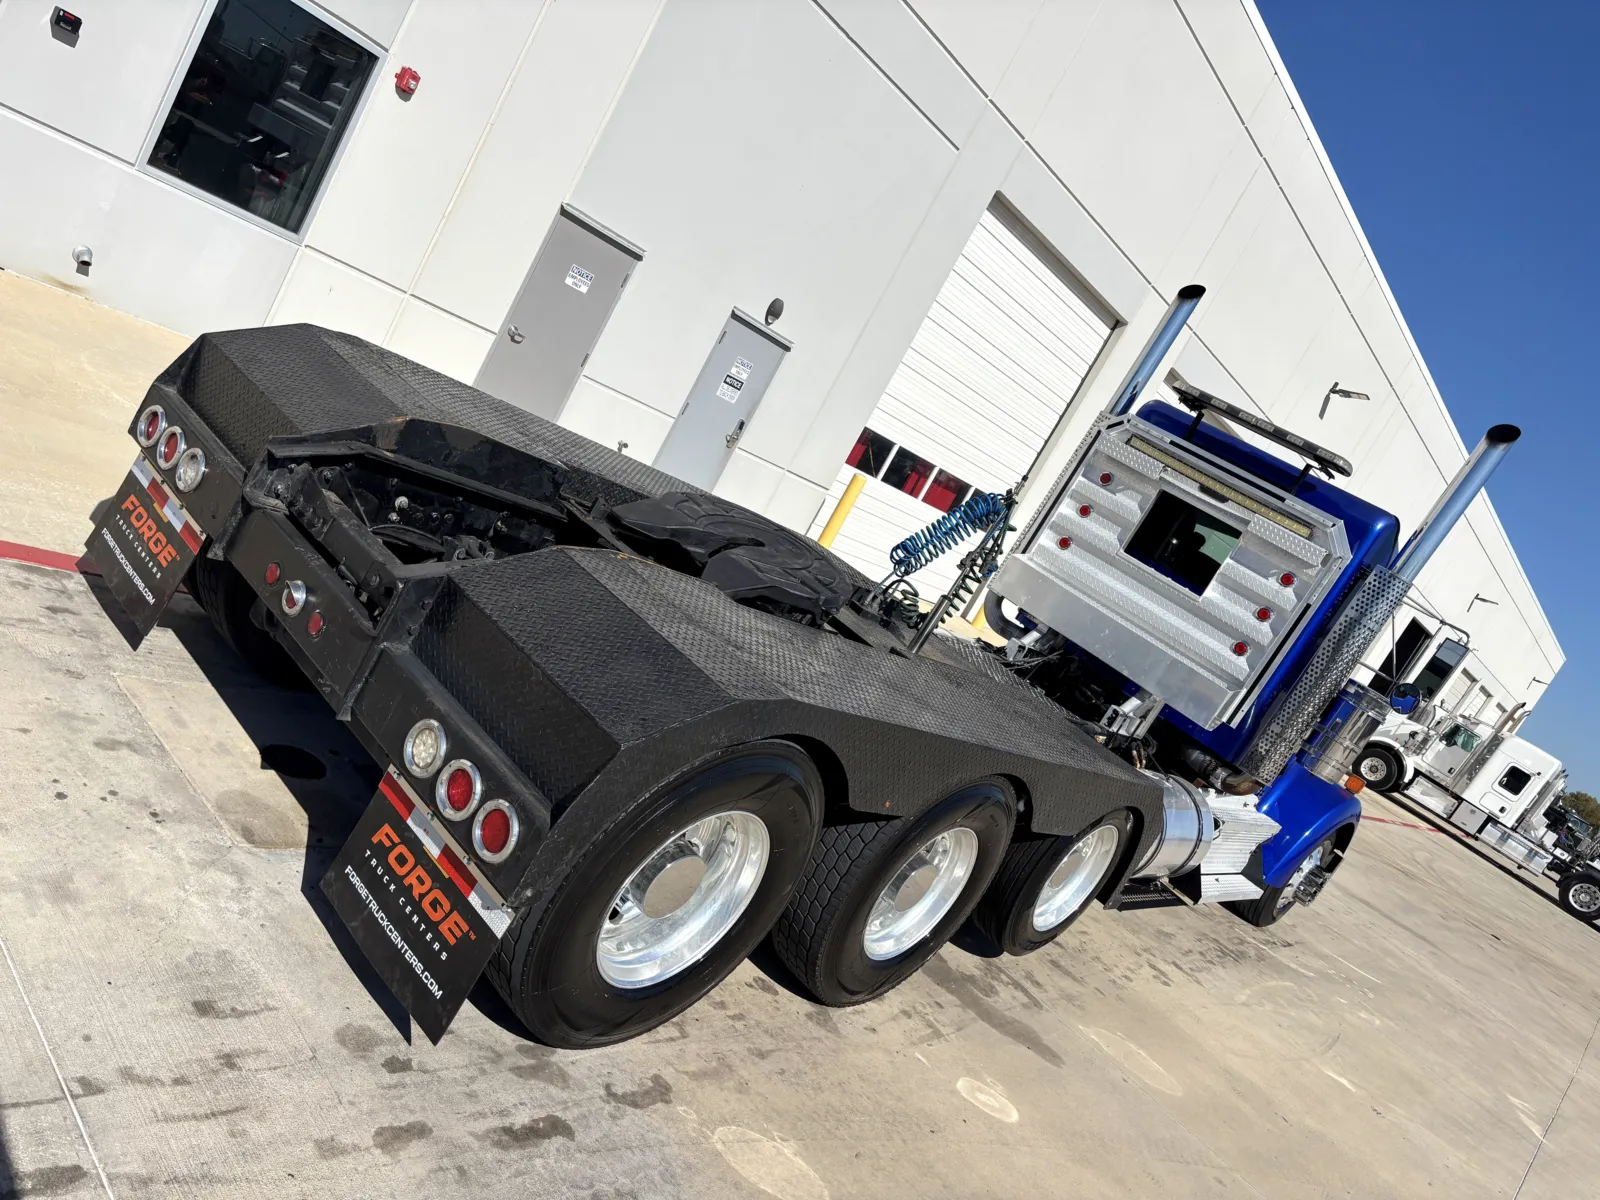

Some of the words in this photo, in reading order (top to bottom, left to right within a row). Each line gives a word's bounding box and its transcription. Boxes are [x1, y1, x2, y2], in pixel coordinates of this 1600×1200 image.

[572, 266, 593, 282] NOTICE
[725, 376, 743, 389] NOTICE
[102, 527, 156, 606] FORGETRUCKCENTERS.COM
[116, 514, 133, 540] TRUCK
[134, 542, 162, 579] CENTERS
[122, 494, 177, 568] FORGE
[364, 849, 396, 893] TRUCK
[399, 897, 448, 961] CENTERS
[371, 823, 470, 946] FORGE
[344, 865, 443, 1000] FORGETRUCKCENTERS.COM
